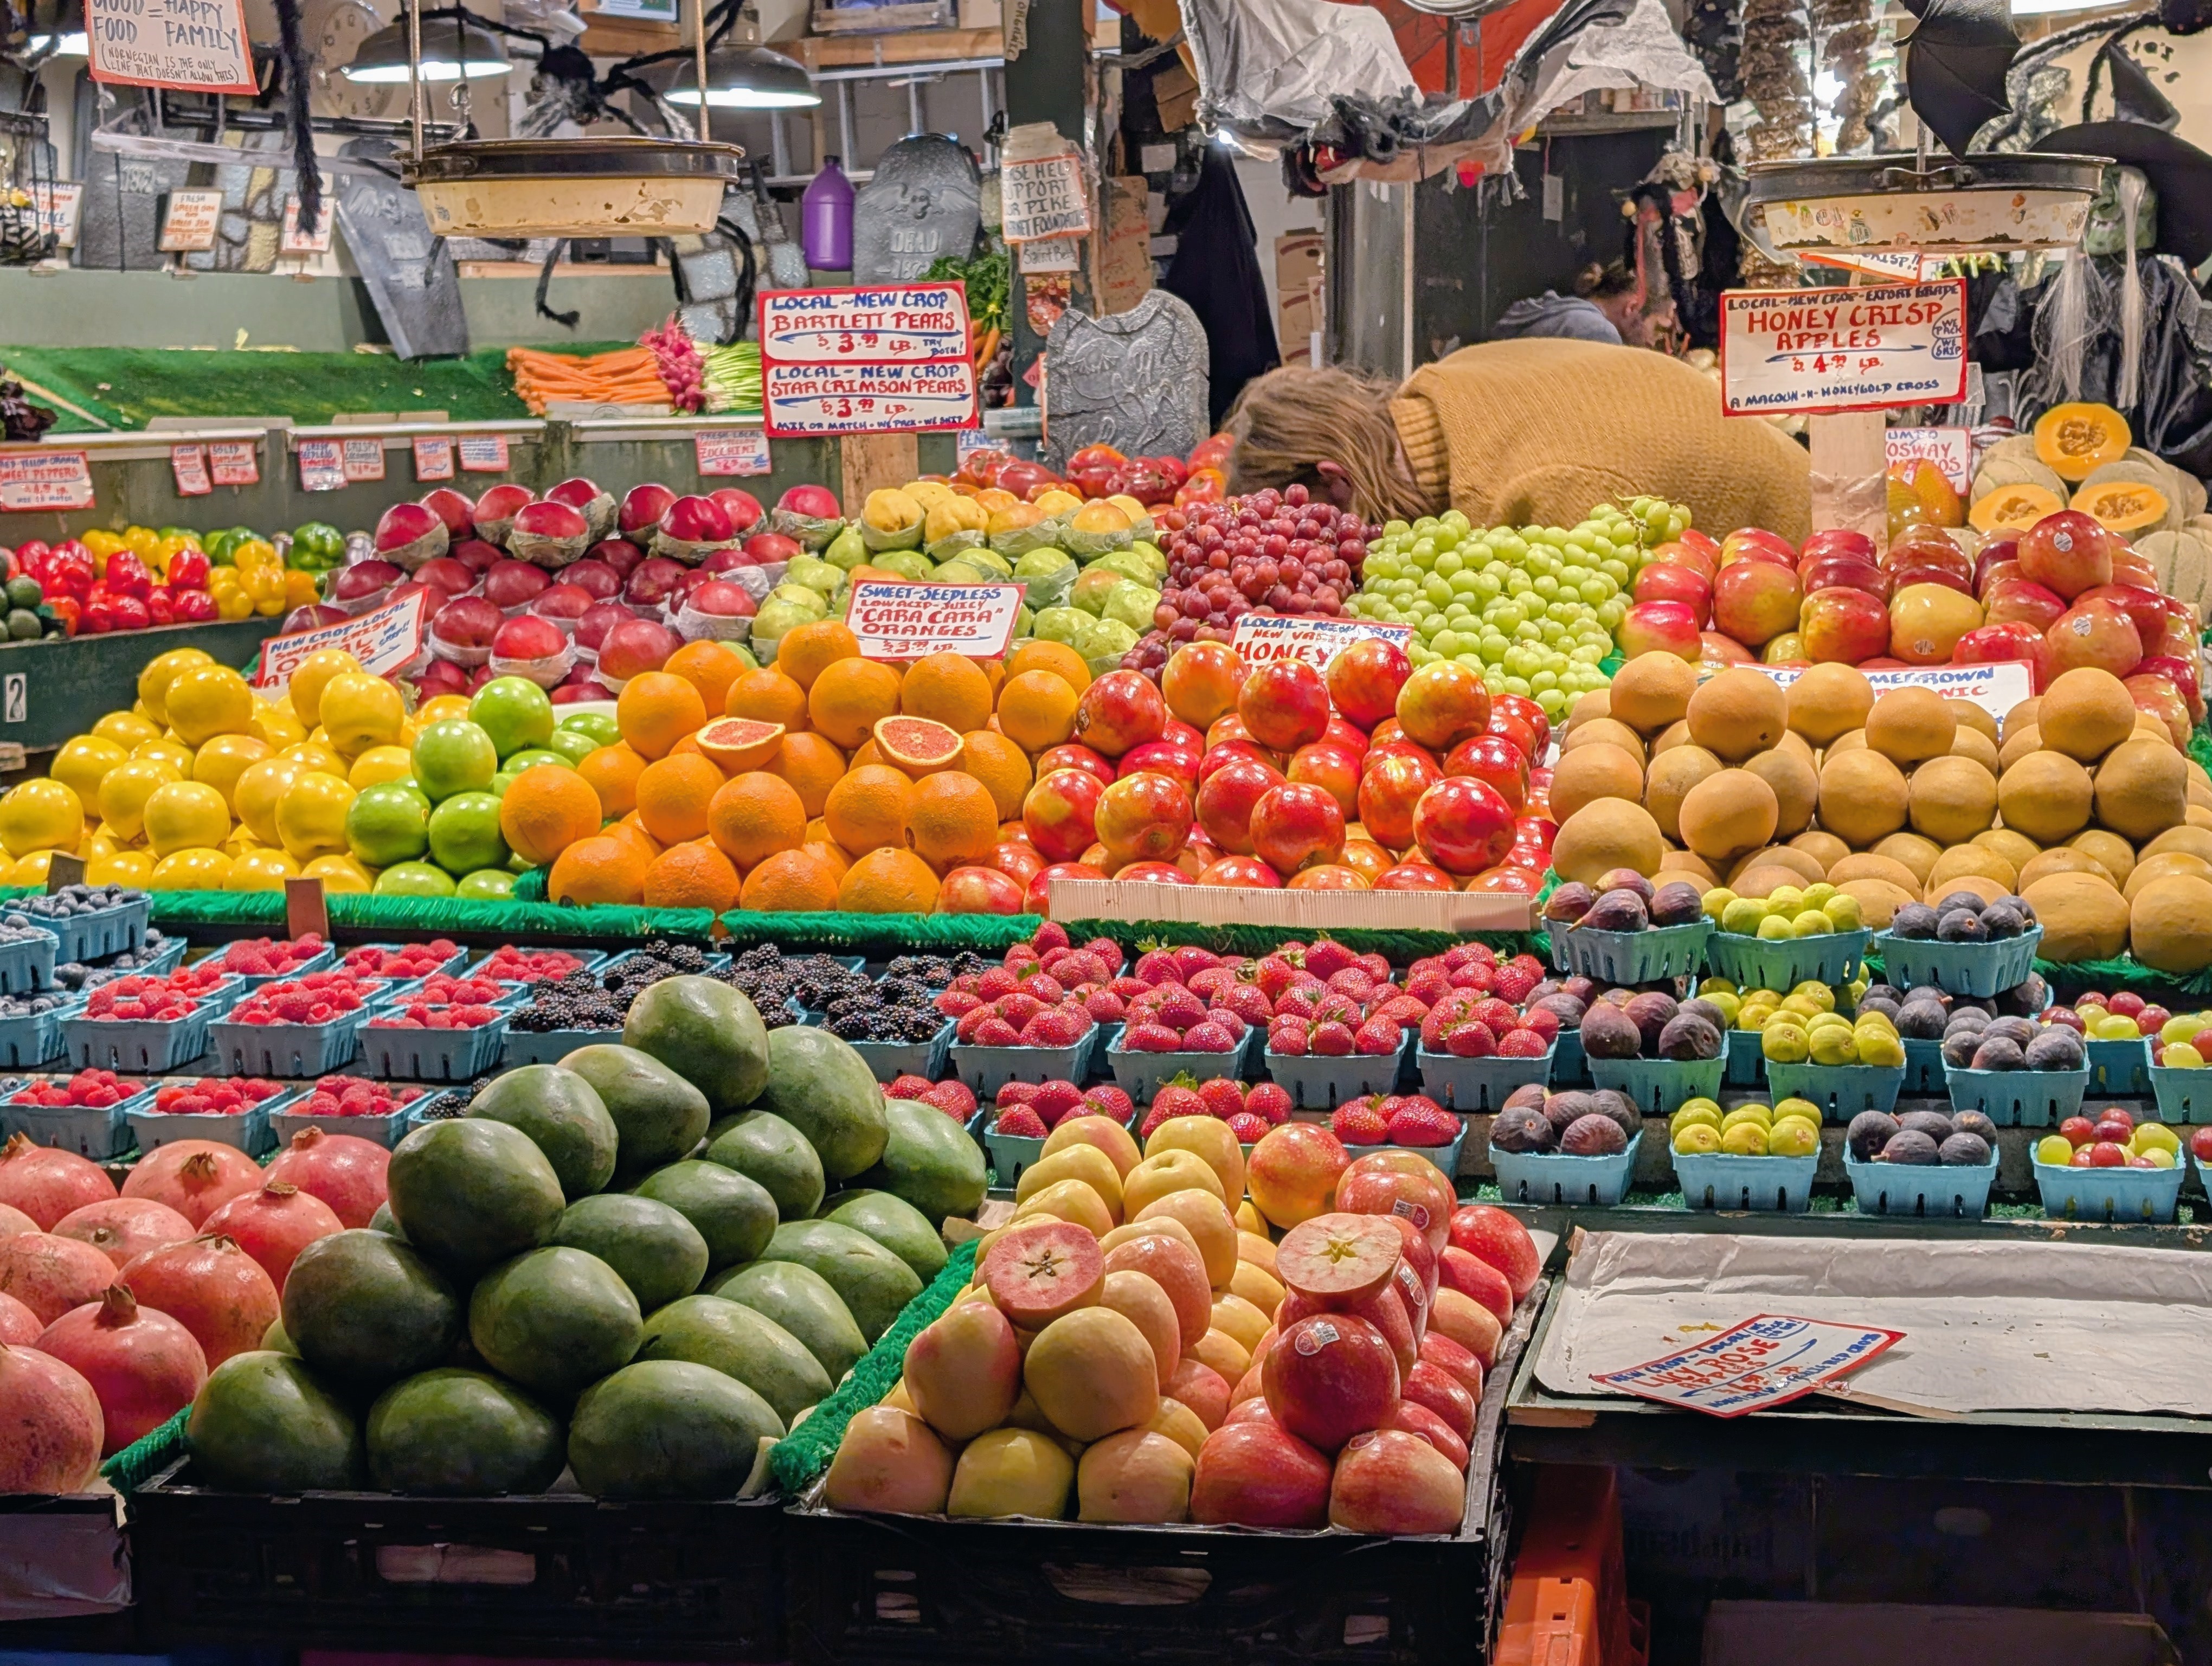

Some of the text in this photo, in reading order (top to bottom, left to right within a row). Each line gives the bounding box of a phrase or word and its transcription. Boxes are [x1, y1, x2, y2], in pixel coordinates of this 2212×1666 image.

[165, 0, 223, 31] HAPPY
[93, 16, 240, 59] FOOD FAMILY
[110, 60, 131, 72] LINE
[135, 63, 153, 78] THAT
[156, 68, 187, 80] DOESN'T
[190, 71, 214, 82] ALLOW
[165, 56, 176, 68] IS
[178, 57, 194, 69] THE
[197, 60, 218, 75] ONLY
[1035, 160, 1071, 179] HELP
[1024, 195, 1070, 215] PIKE
[890, 230, 942, 253] DEAD
[771, 294, 838, 311] LOCAL
[902, 291, 948, 310] CROP
[1915, 283, 1958, 300] GRADE
[768, 311, 955, 338] BARTLETT PEARS
[1747, 302, 1943, 334] HONEY CRISP
[1942, 318, 1958, 326] WE
[1935, 325, 1962, 334] PACK
[923, 338, 942, 347] TRY
[1777, 329, 1882, 351] APPLES
[1943, 338, 1956, 347] WE
[1936, 345, 1962, 356] SHIP
[860, 366, 904, 379] NEW
[911, 364, 960, 379] CROP
[770, 379, 967, 398] STAR CRIMSON PEARS
[1730, 397, 1740, 409] A
[1745, 389, 1798, 406] MACOUN
[1896, 379, 1940, 391] CROSS
[776, 421, 806, 431] MIX
[828, 421, 867, 431] MATCH
[877, 419, 891, 428] WE
[1887, 442, 1952, 458] OSWAY
[33, 467, 78, 480] PEPPERS
[861, 623, 977, 637] ORANGES
[1252, 629, 1283, 639] NEW
[271, 636, 306, 654] NEW
[1234, 640, 1332, 667] HONEY
[1607, 1370, 1646, 1382] NEW
[1698, 1332, 1751, 1354] LOCAL
[1822, 1352, 1851, 1366] RED
[1846, 1333, 1882, 1354] CROSS
[1631, 1339, 1780, 1387] LUCY ROSE
[1677, 1361, 1767, 1389] APPLES
